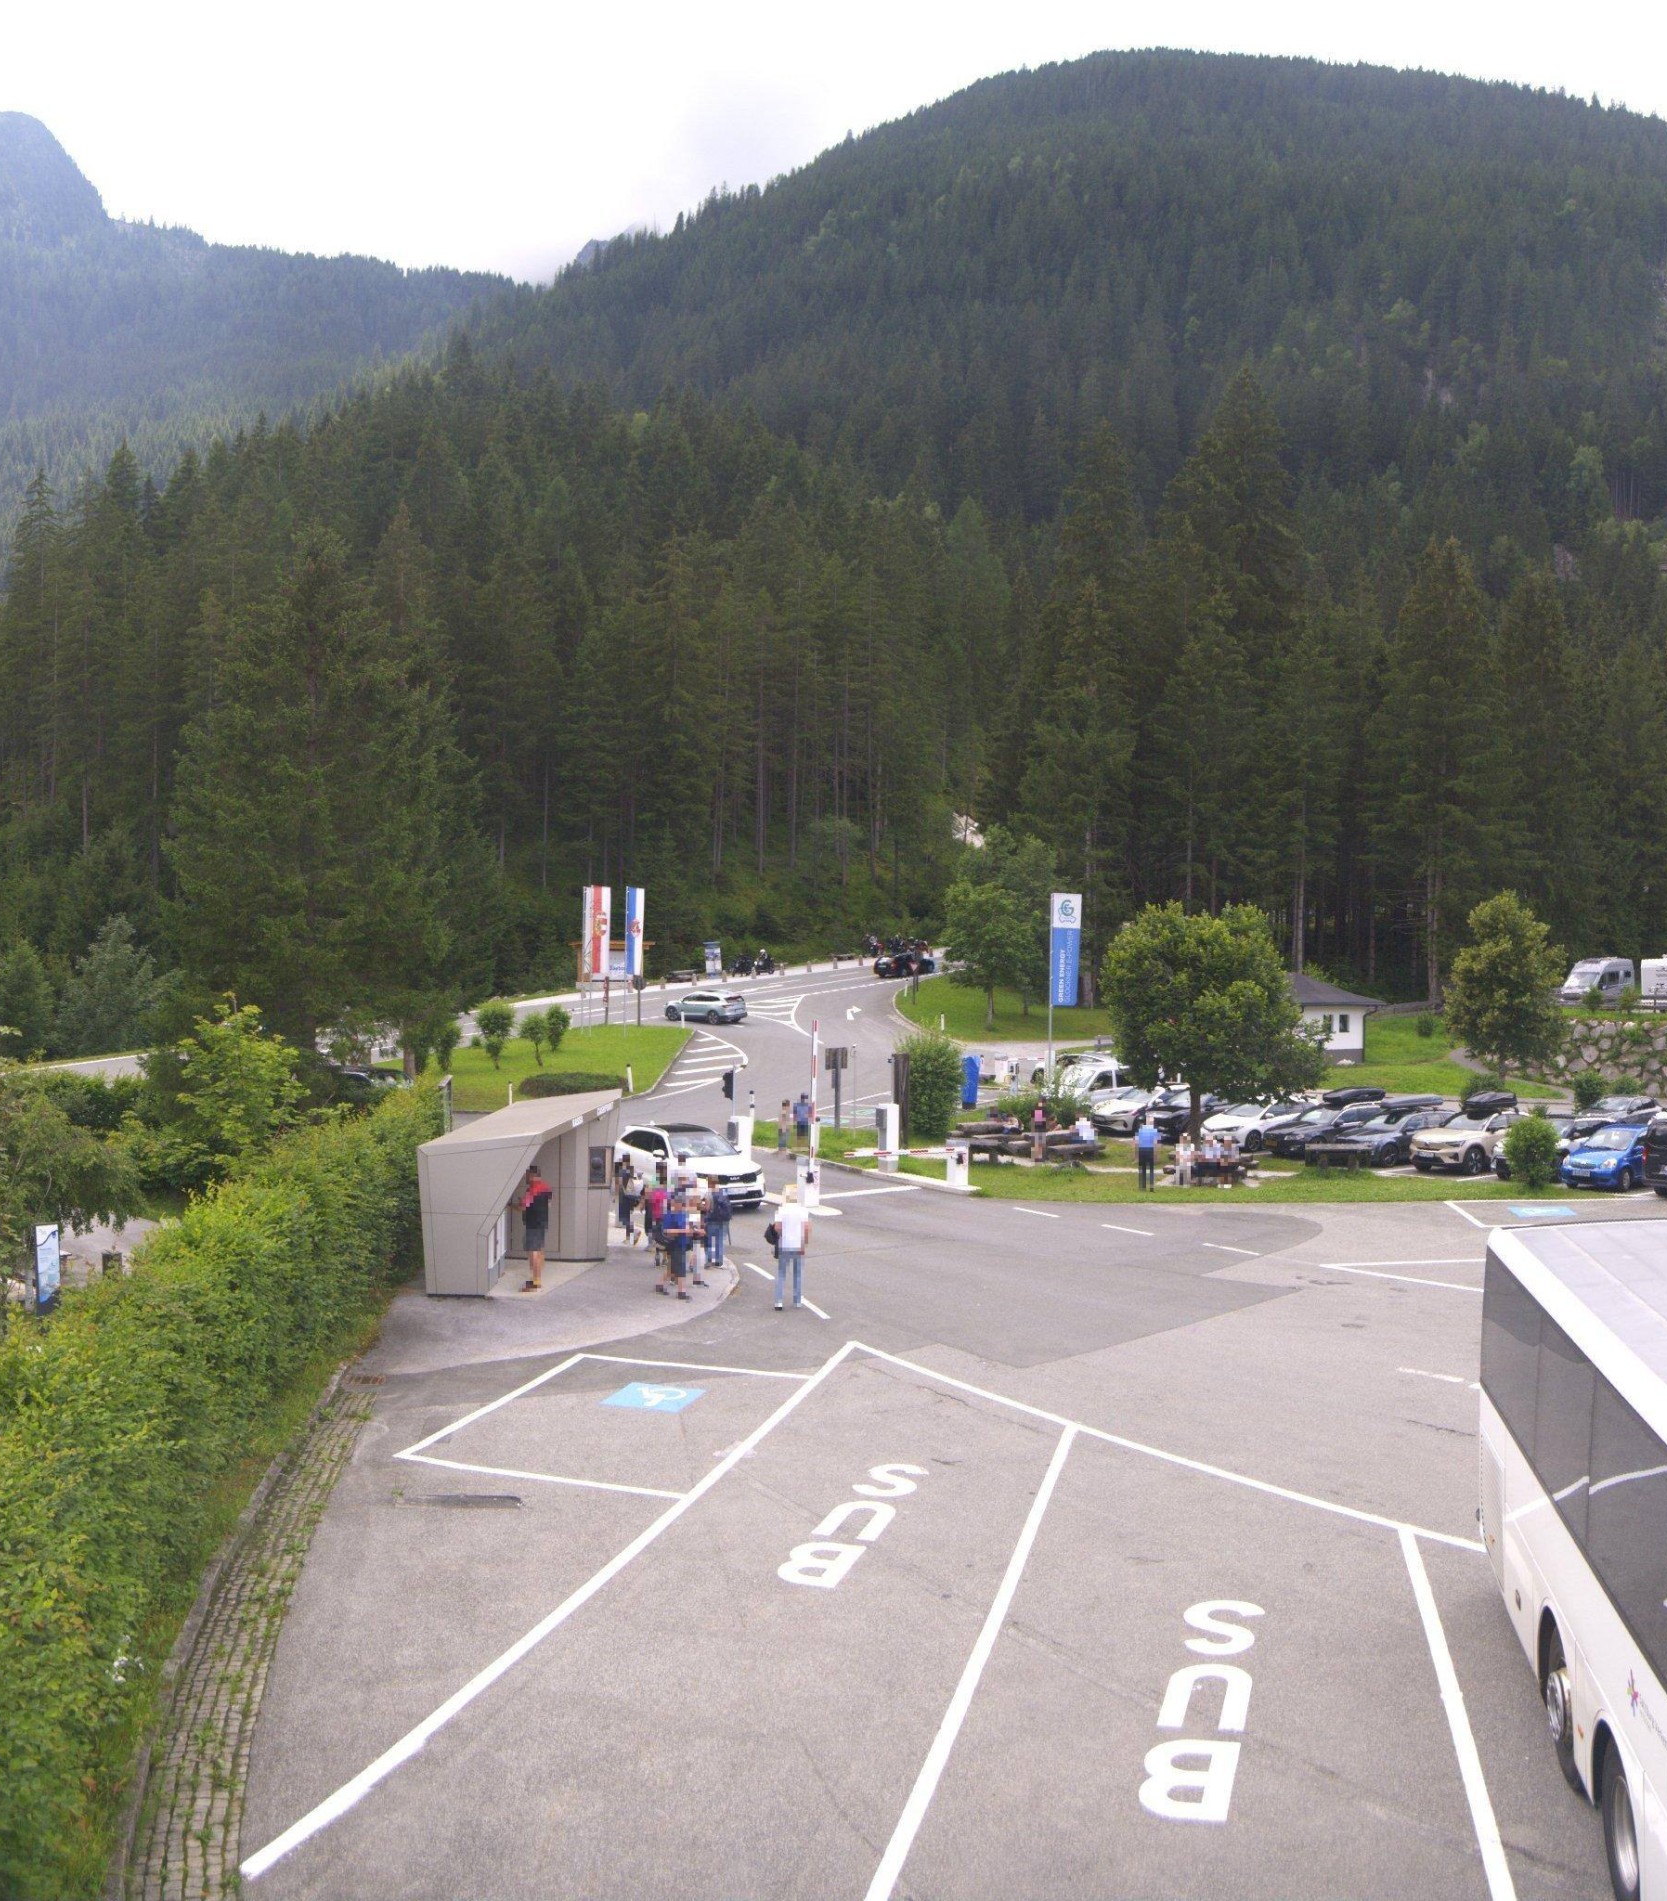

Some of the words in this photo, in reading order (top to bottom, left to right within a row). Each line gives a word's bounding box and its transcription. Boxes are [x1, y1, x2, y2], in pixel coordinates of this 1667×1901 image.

[1065, 965, 1073, 1003] GLOCKNER
[1066, 930, 1074, 964] E-POWER
[777, 1463, 930, 1588] BUS
[1138, 1600, 1266, 1822] BUS
